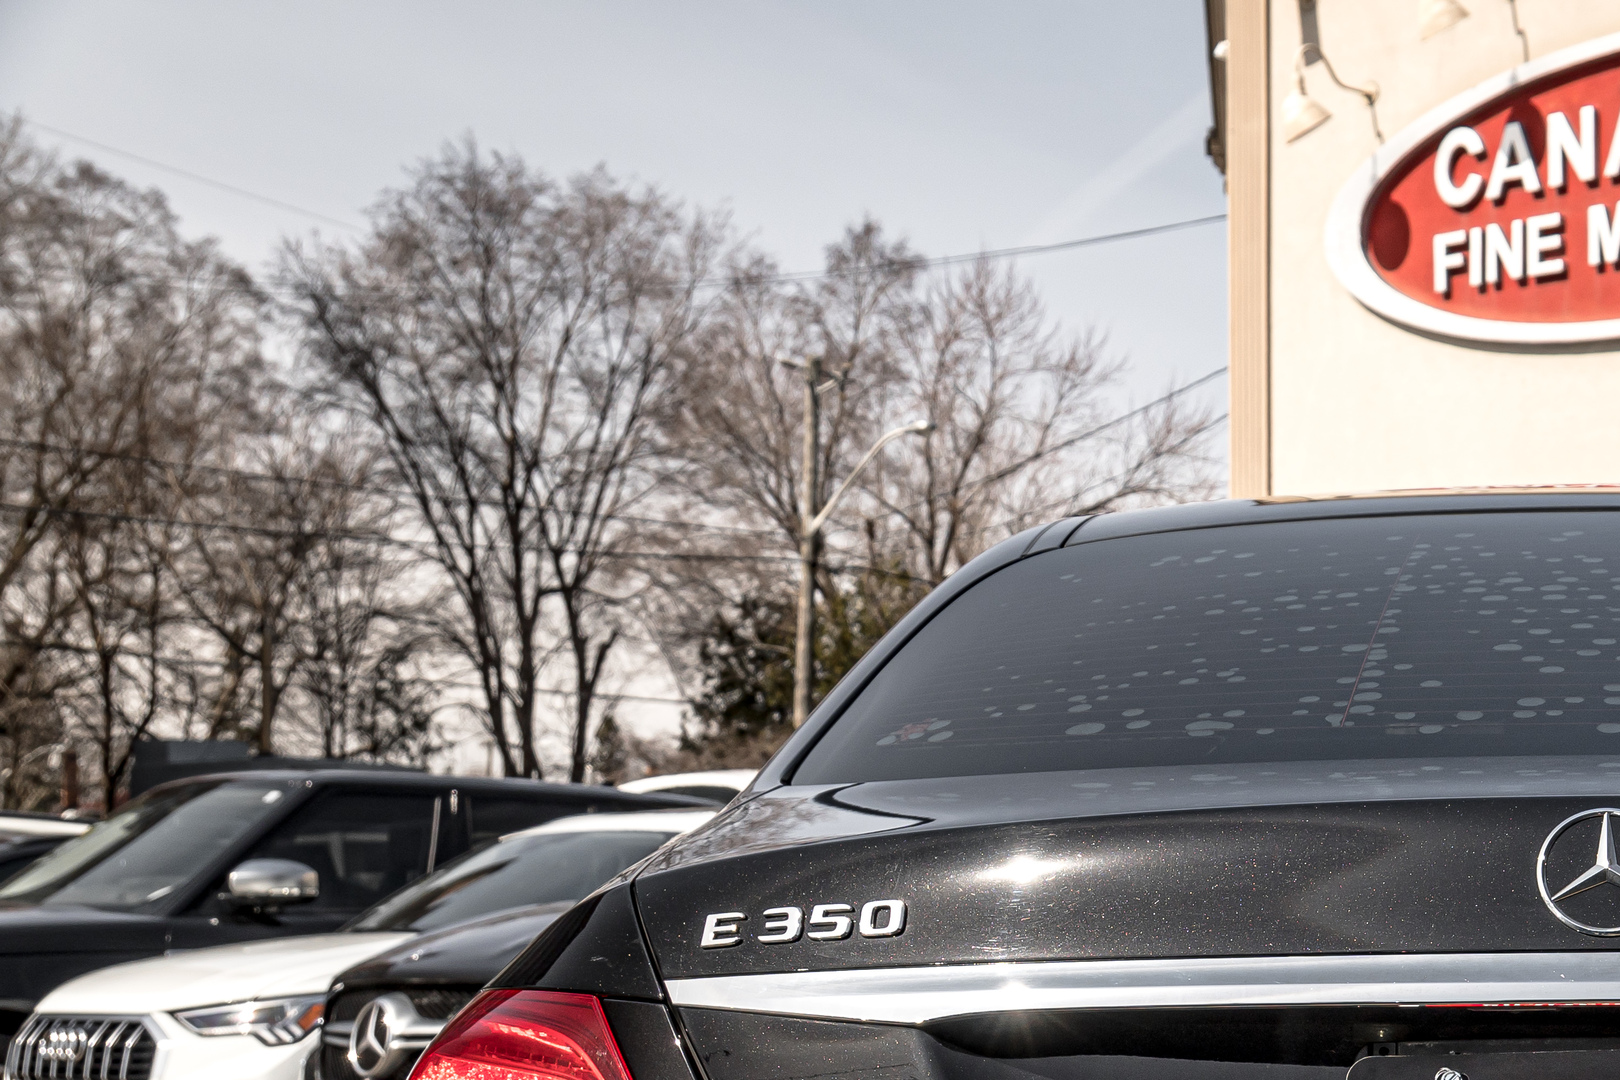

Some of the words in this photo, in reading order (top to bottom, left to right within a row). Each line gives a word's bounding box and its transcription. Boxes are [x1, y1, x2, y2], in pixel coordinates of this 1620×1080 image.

[1432, 214, 1565, 294] FINE
[700, 911, 747, 950] E
[757, 899, 908, 943] 350
